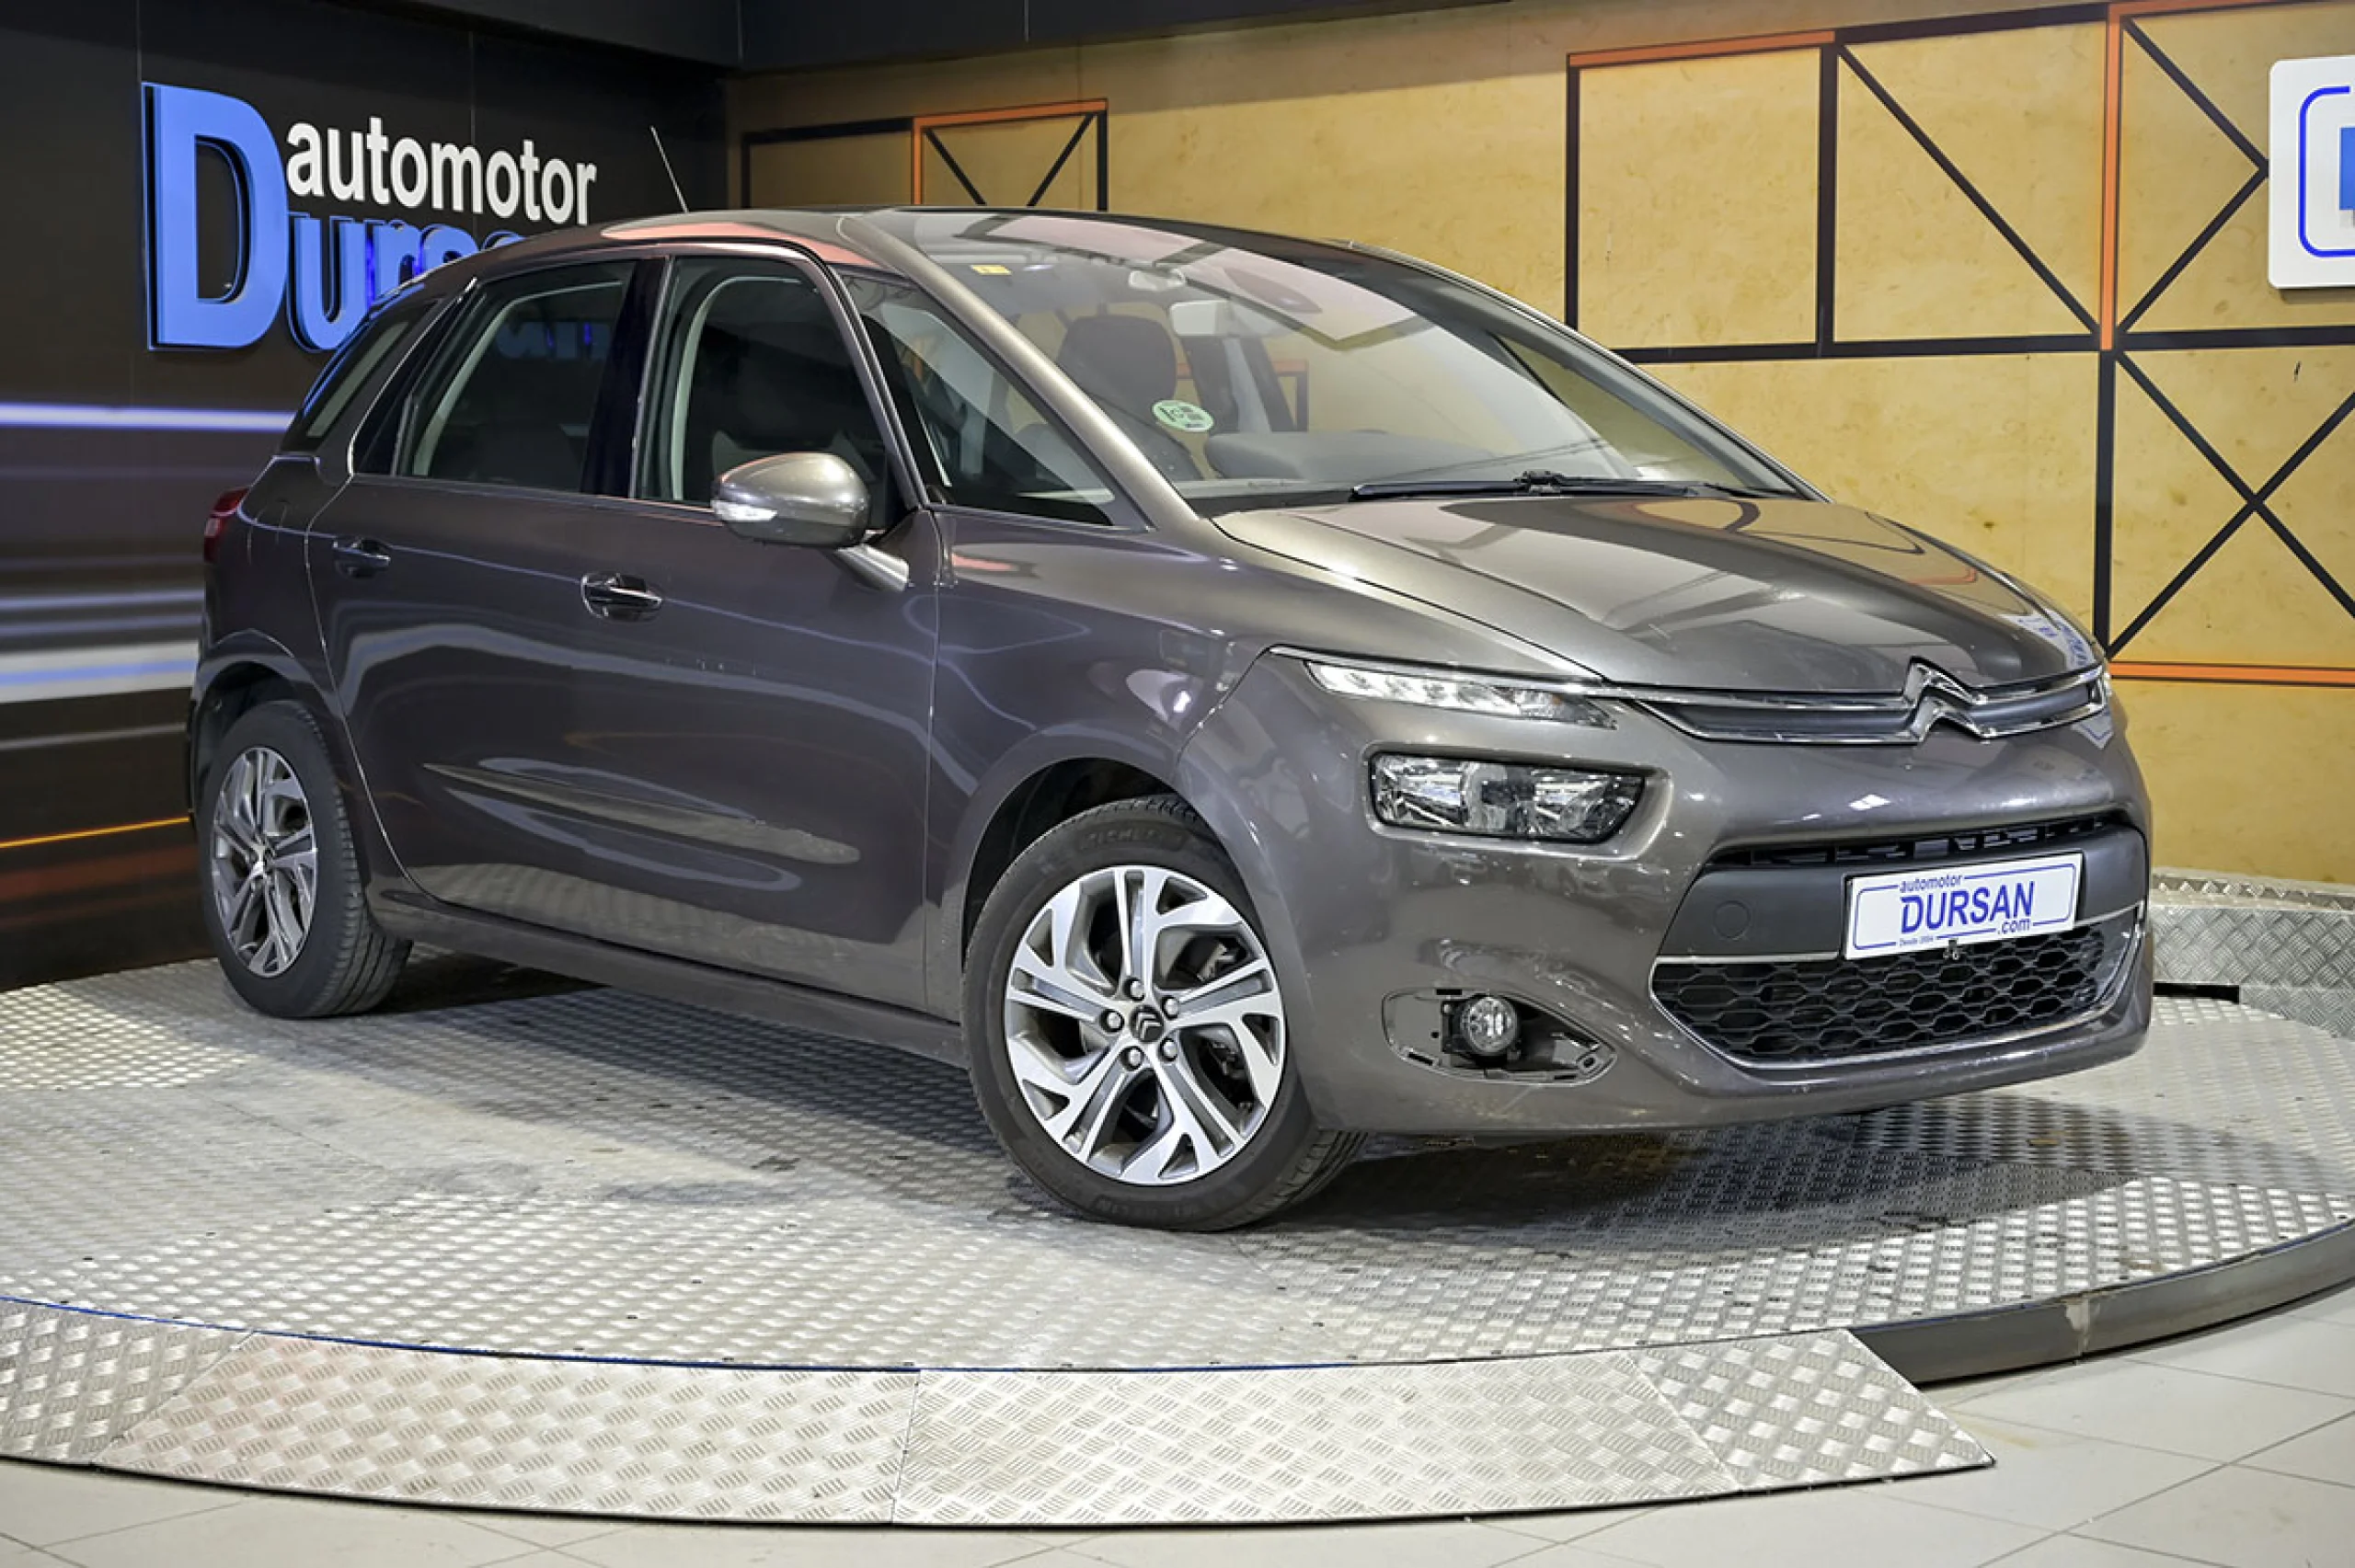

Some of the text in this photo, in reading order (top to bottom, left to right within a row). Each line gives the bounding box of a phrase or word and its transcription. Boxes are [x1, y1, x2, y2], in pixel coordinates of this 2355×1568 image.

[286, 116, 597, 224] automotor
[1900, 874, 1961, 893] automotor
[1900, 880, 2035, 933] DURSAN
[1997, 919, 2030, 934] .com
